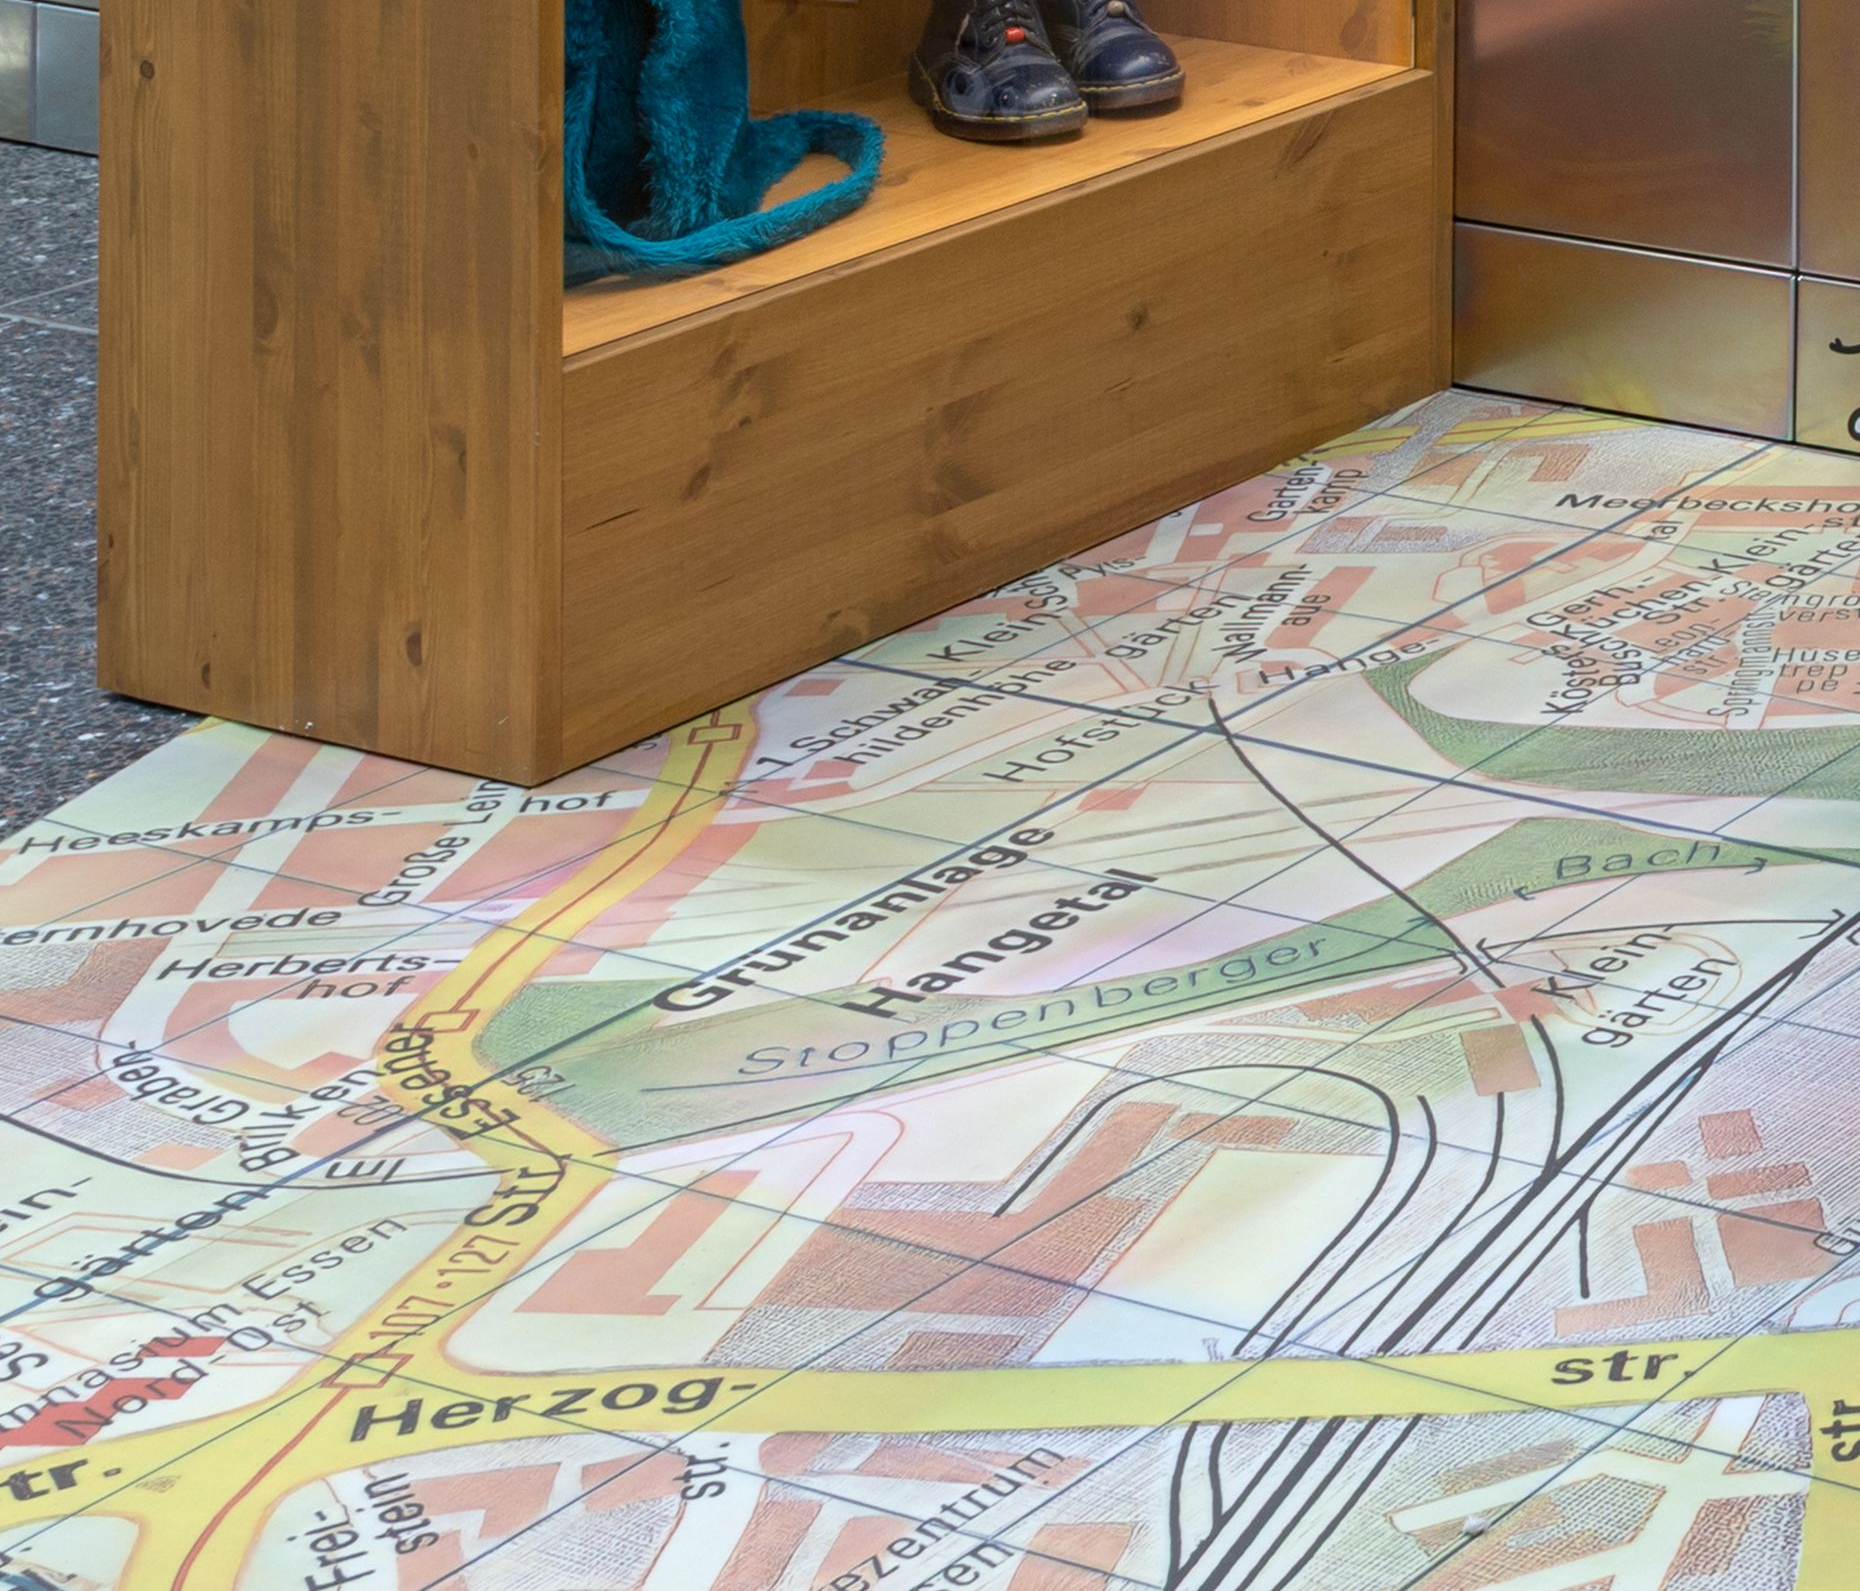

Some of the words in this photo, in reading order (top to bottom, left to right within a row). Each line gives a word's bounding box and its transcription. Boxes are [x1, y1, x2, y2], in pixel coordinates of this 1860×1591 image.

[1211, 560, 1314, 666] Wallmann-
[1283, 592, 1334, 631] aue
[1255, 637, 1442, 688] Hange-
[983, 680, 1218, 783] Hofstück
[16, 805, 404, 857] Heeskamps-
[516, 789, 619, 816] hof
[1555, 840, 1723, 881] Bach
[356, 834, 473, 913] Große
[650, 825, 1055, 1014] Grünanlage
[840, 868, 1159, 1019] Hangetal
[158, 950, 464, 983] Herberts-
[297, 974, 416, 1002] hof
[1530, 922, 1681, 1005] Klein-
[1580, 949, 1741, 1049] gärten
[112, 1041, 251, 1125] Graben-
[33, 1188, 272, 1302] gärten
[241, 1218, 407, 1300] Essen
[1550, 1347, 1698, 1387] str.
[348, 1374, 761, 1442] Herzog-
